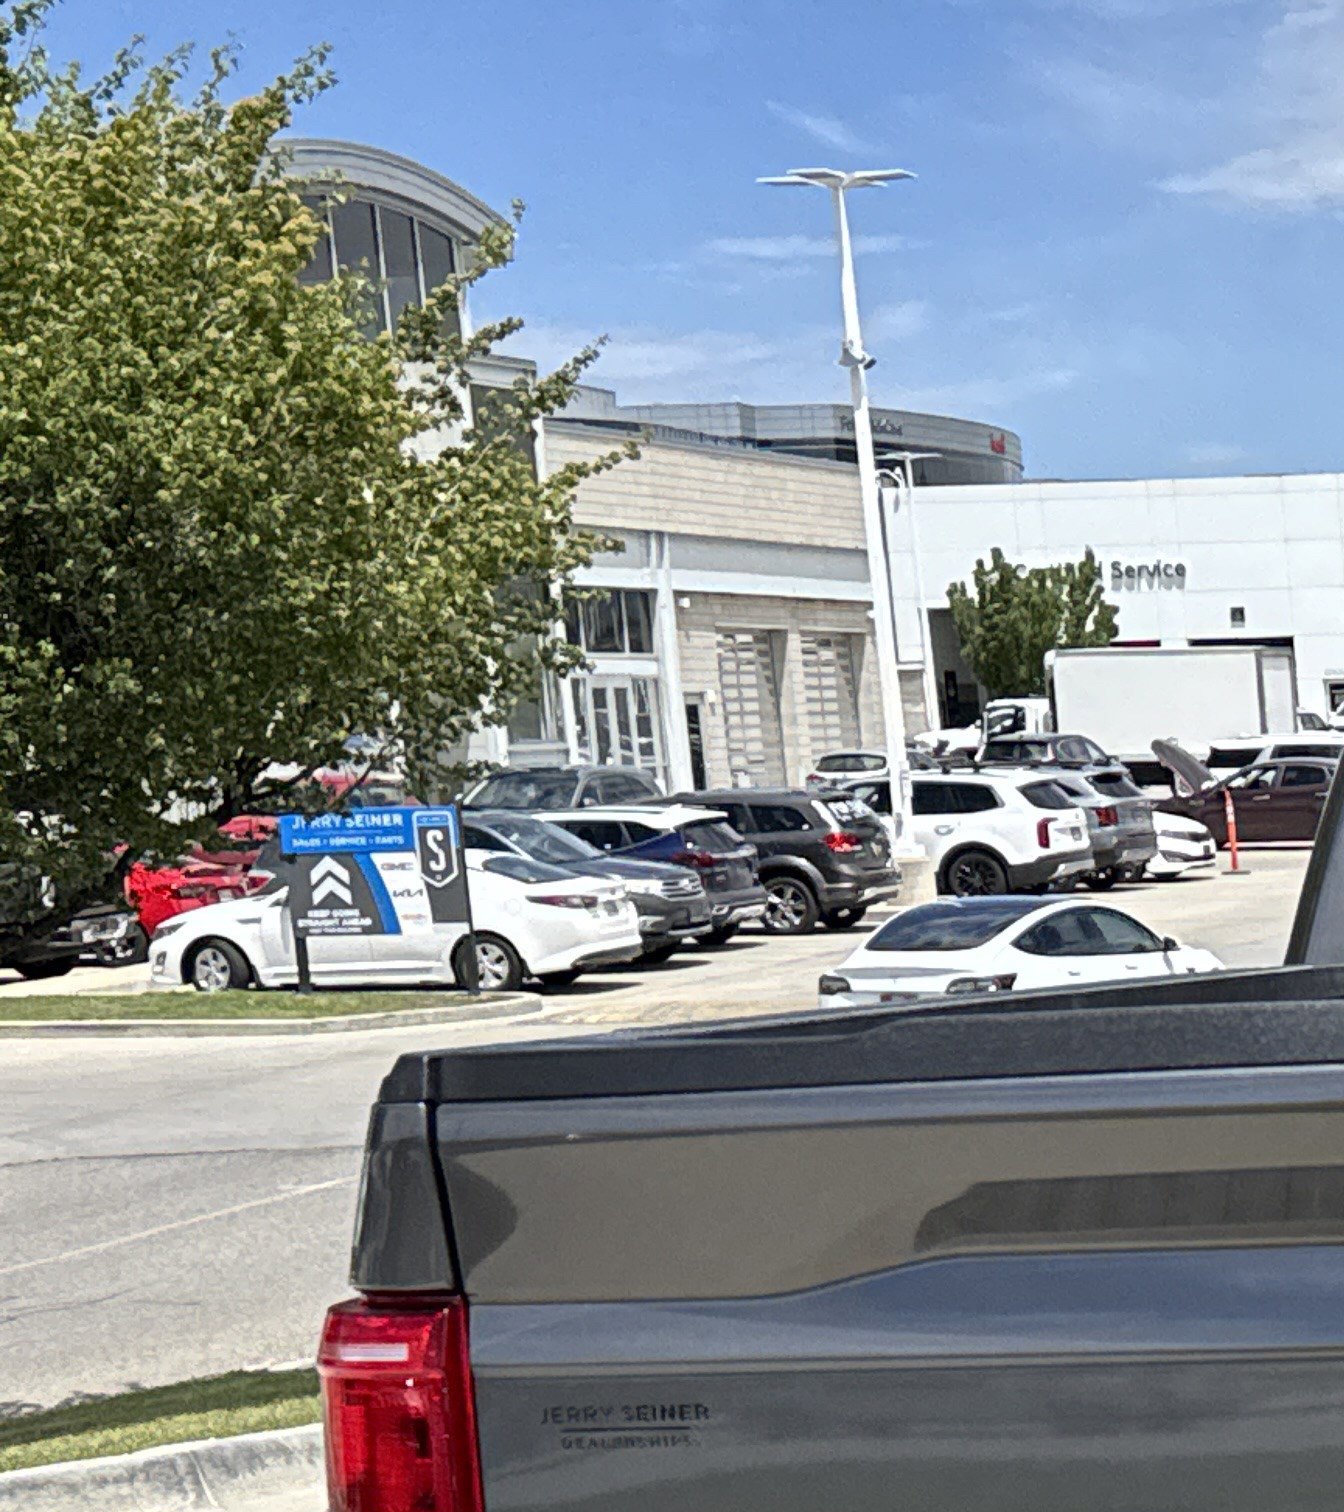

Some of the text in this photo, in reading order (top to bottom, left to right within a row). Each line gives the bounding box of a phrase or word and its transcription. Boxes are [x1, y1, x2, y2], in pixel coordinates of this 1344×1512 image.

[1111, 559, 1187, 579] Service
[345, 813, 404, 829] SEINER
[541, 1403, 710, 1425] JERRY SEINER
